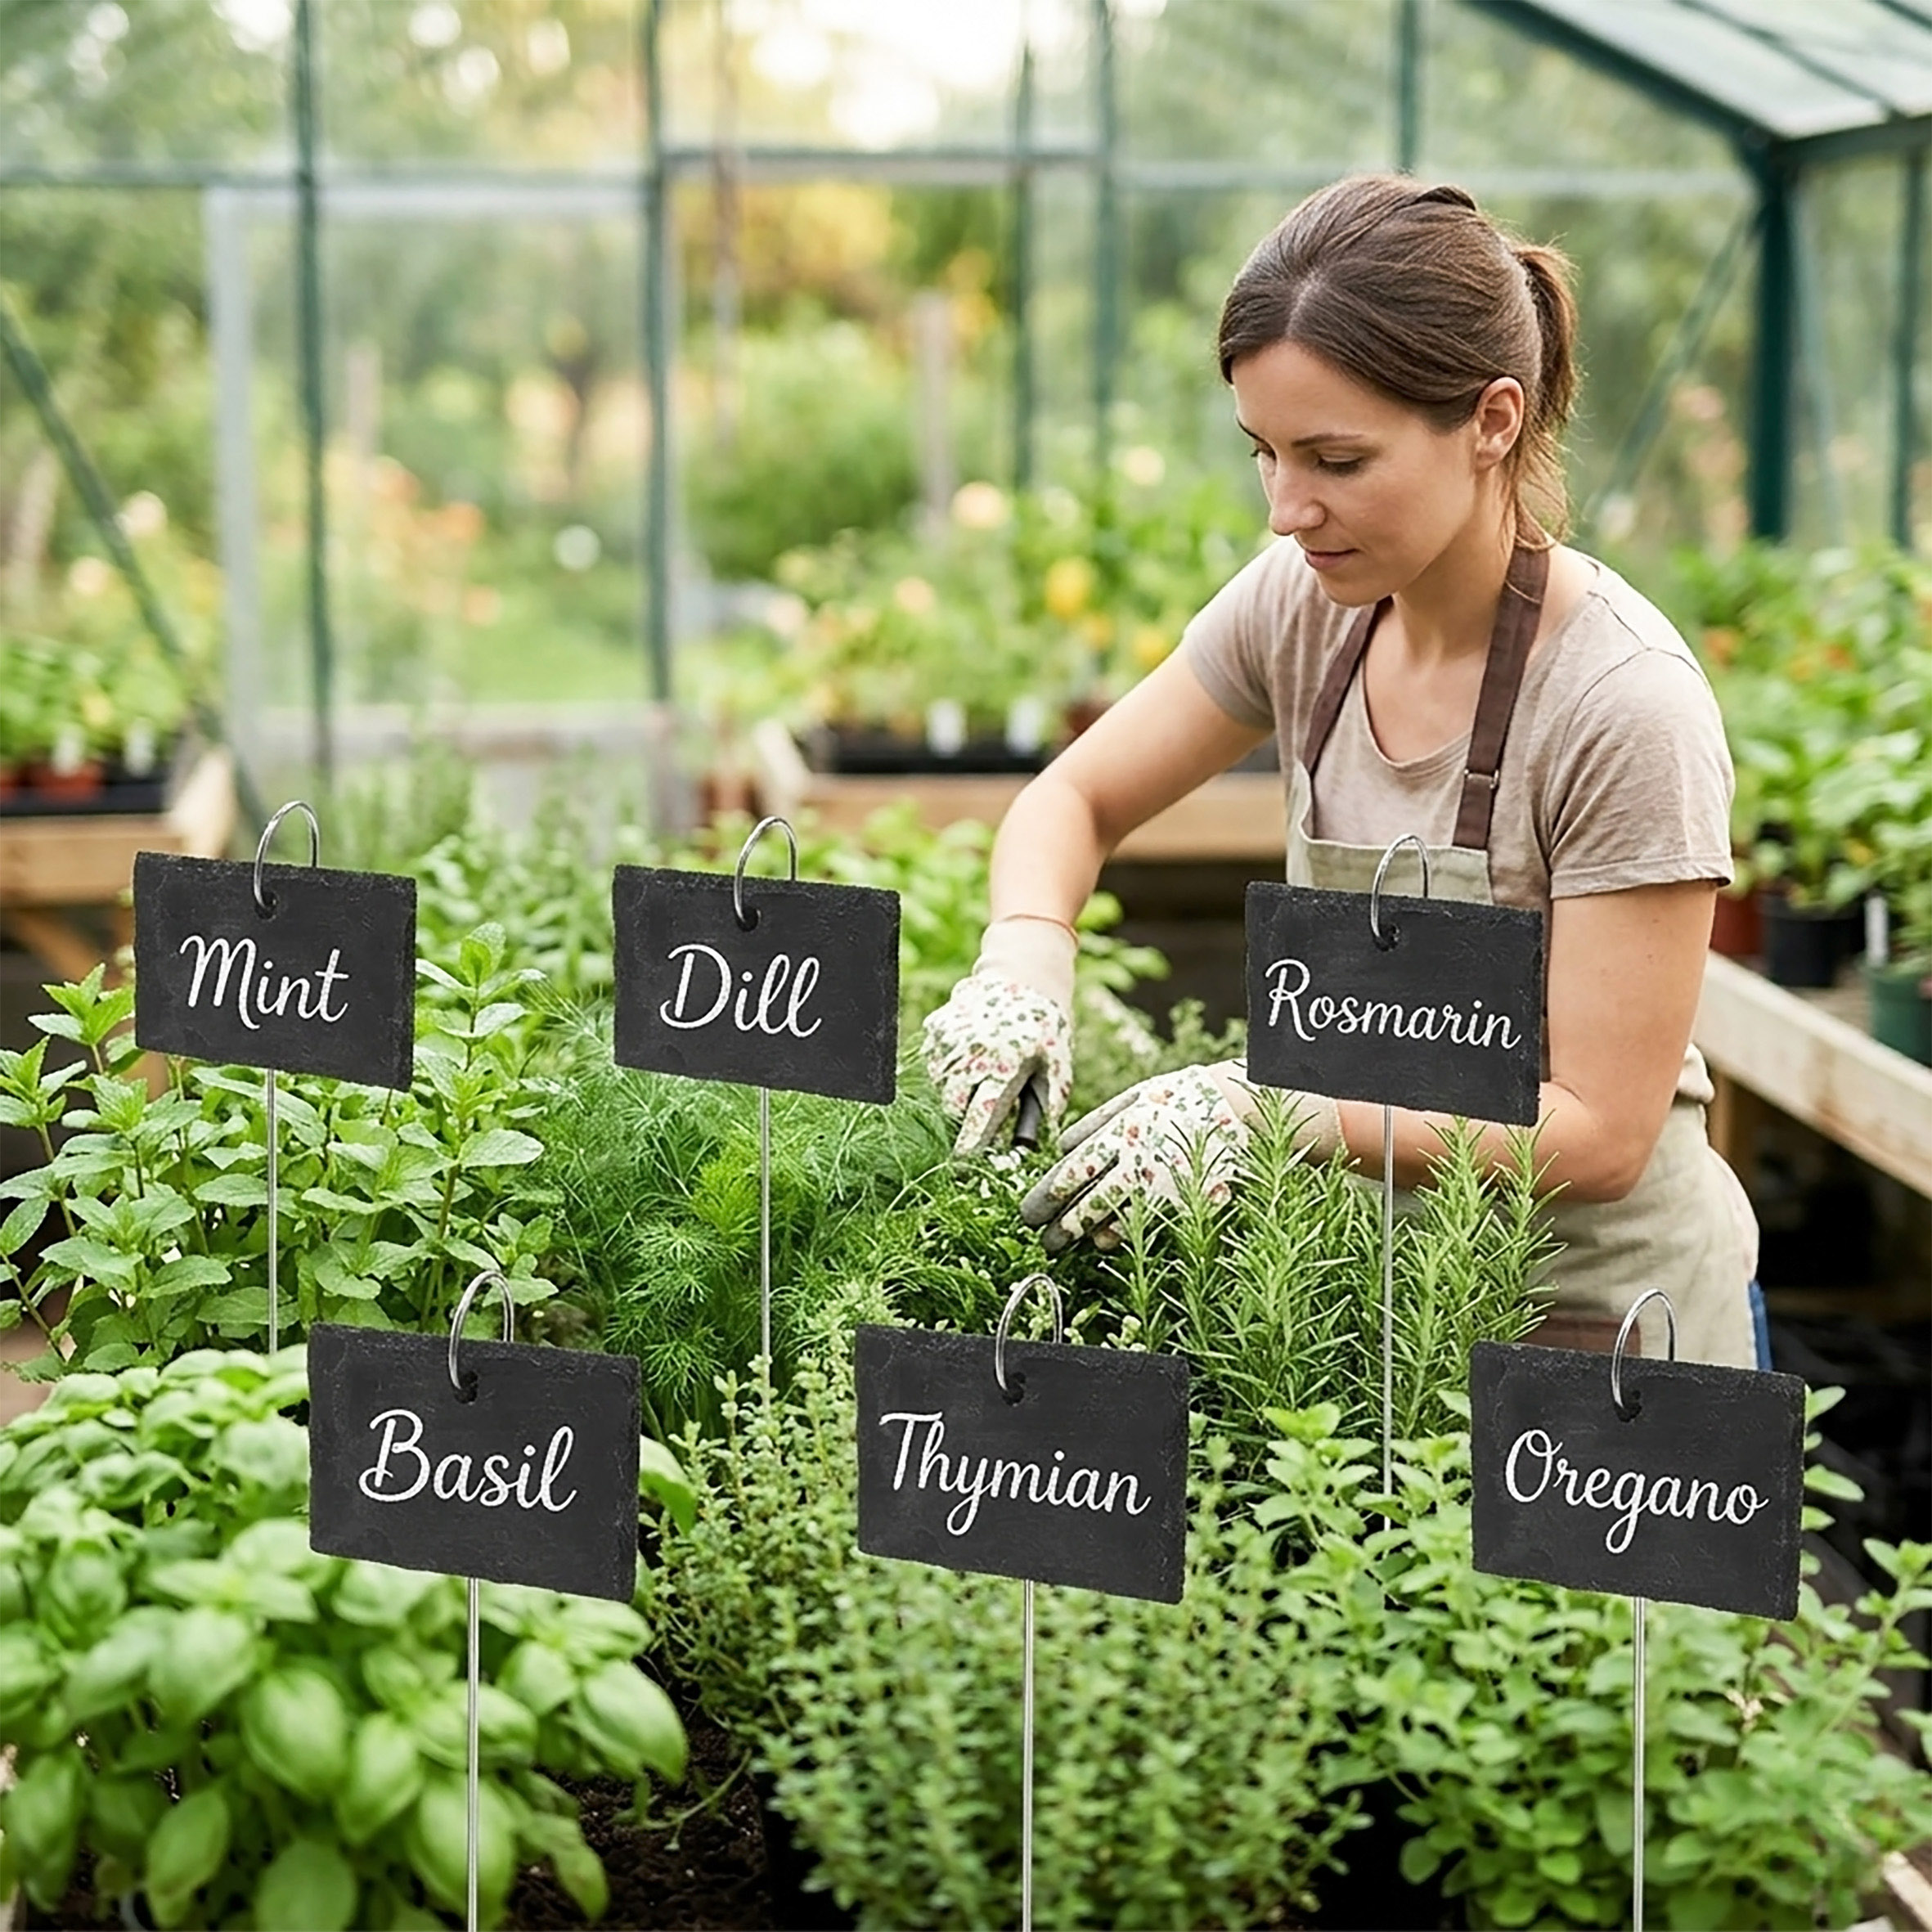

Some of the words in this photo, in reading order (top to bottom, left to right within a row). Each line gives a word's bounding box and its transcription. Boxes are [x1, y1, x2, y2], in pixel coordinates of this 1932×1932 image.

[179, 935, 349, 1030] Mint
[659, 943, 822, 1038] Dill
[1265, 959, 1521, 1051] Rosmarin
[358, 1409, 577, 1512] Basil
[878, 1411, 1152, 1536] Thymian
[1505, 1429, 1769, 1554] Oregano
